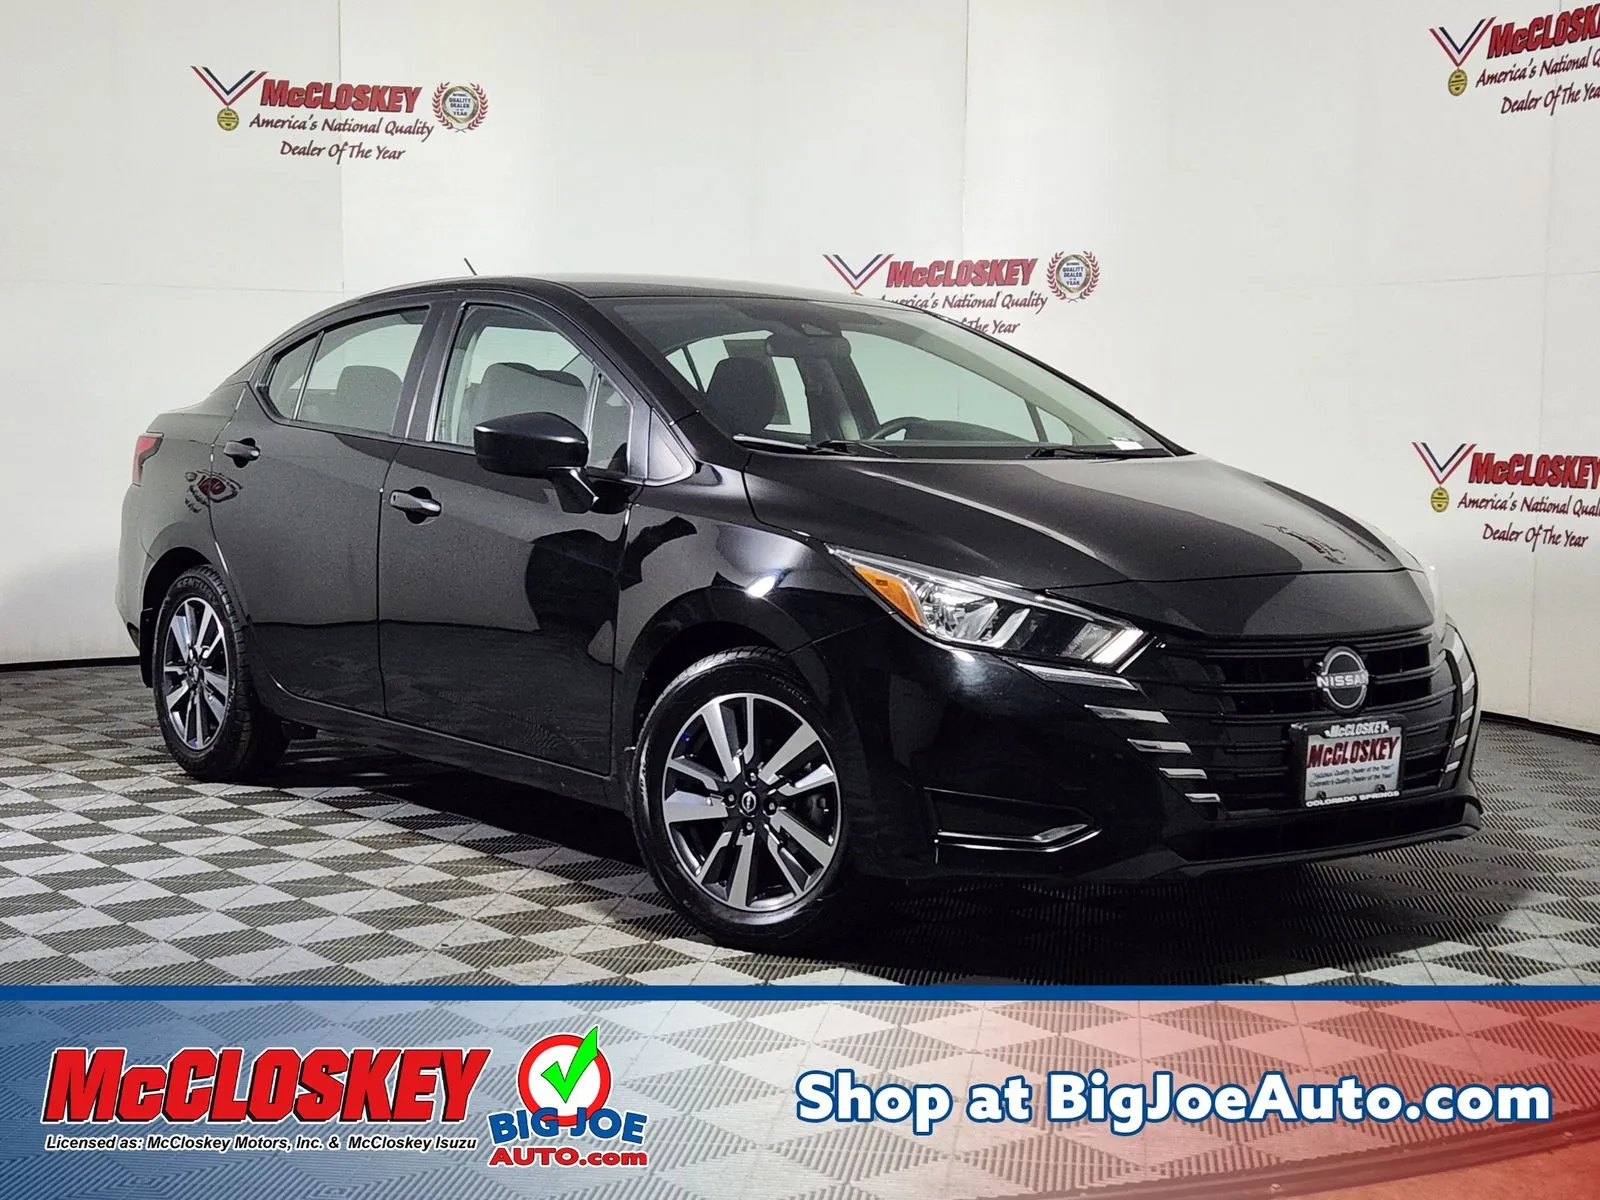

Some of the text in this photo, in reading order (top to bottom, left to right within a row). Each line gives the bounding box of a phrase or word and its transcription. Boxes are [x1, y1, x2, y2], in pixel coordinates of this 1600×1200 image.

[1487, 3, 1600, 59] McCLOSK
[1475, 58, 1537, 88] America's
[1539, 46, 1592, 77] National
[260, 79, 422, 113] McCLOSKEY
[1500, 89, 1543, 114] Dealer
[1544, 85, 1562, 116] Of
[1561, 82, 1581, 105] The
[249, 113, 317, 131] America's
[321, 117, 380, 134] National
[385, 118, 434, 143] Quality
[280, 140, 406, 165] Dealer Of The Year
[886, 258, 1039, 288] McCLOSKEY
[942, 290, 1002, 309] National
[1001, 290, 1048, 315] Quality
[991, 319, 1020, 334] Year
[1457, 491, 1517, 511] America's
[1520, 495, 1573, 514] National
[1482, 522, 1589, 552] Dealer Of The Year
[1316, 674, 1369, 688] NISSAN
[1329, 721, 1389, 737] McCLOSKEY
[1306, 736, 1400, 768] McCLOSKEY
[1306, 790, 1400, 807] COLORADO SPRINGS
